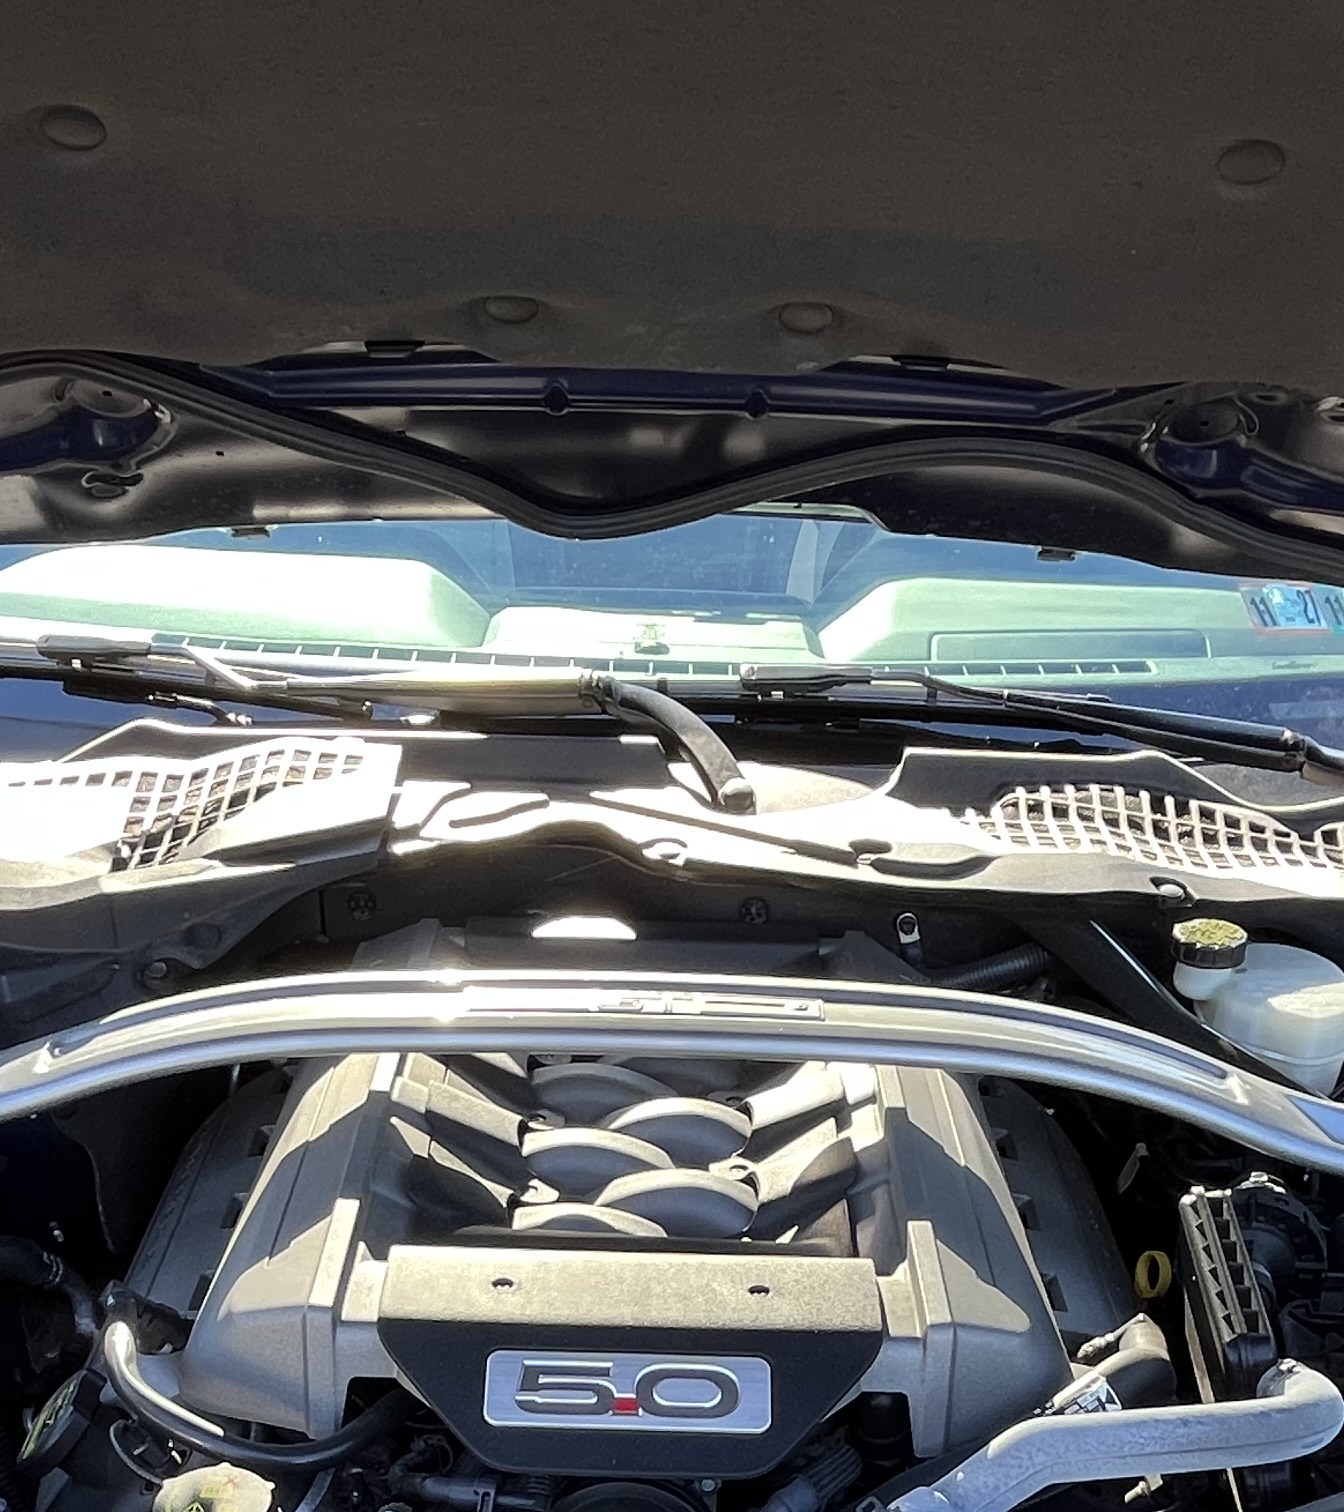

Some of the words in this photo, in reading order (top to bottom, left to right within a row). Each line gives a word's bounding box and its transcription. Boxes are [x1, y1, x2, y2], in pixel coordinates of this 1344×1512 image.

[1250, 597, 1278, 627] 11
[1297, 590, 1322, 627] 27
[513, 1358, 740, 1419] 5.0
